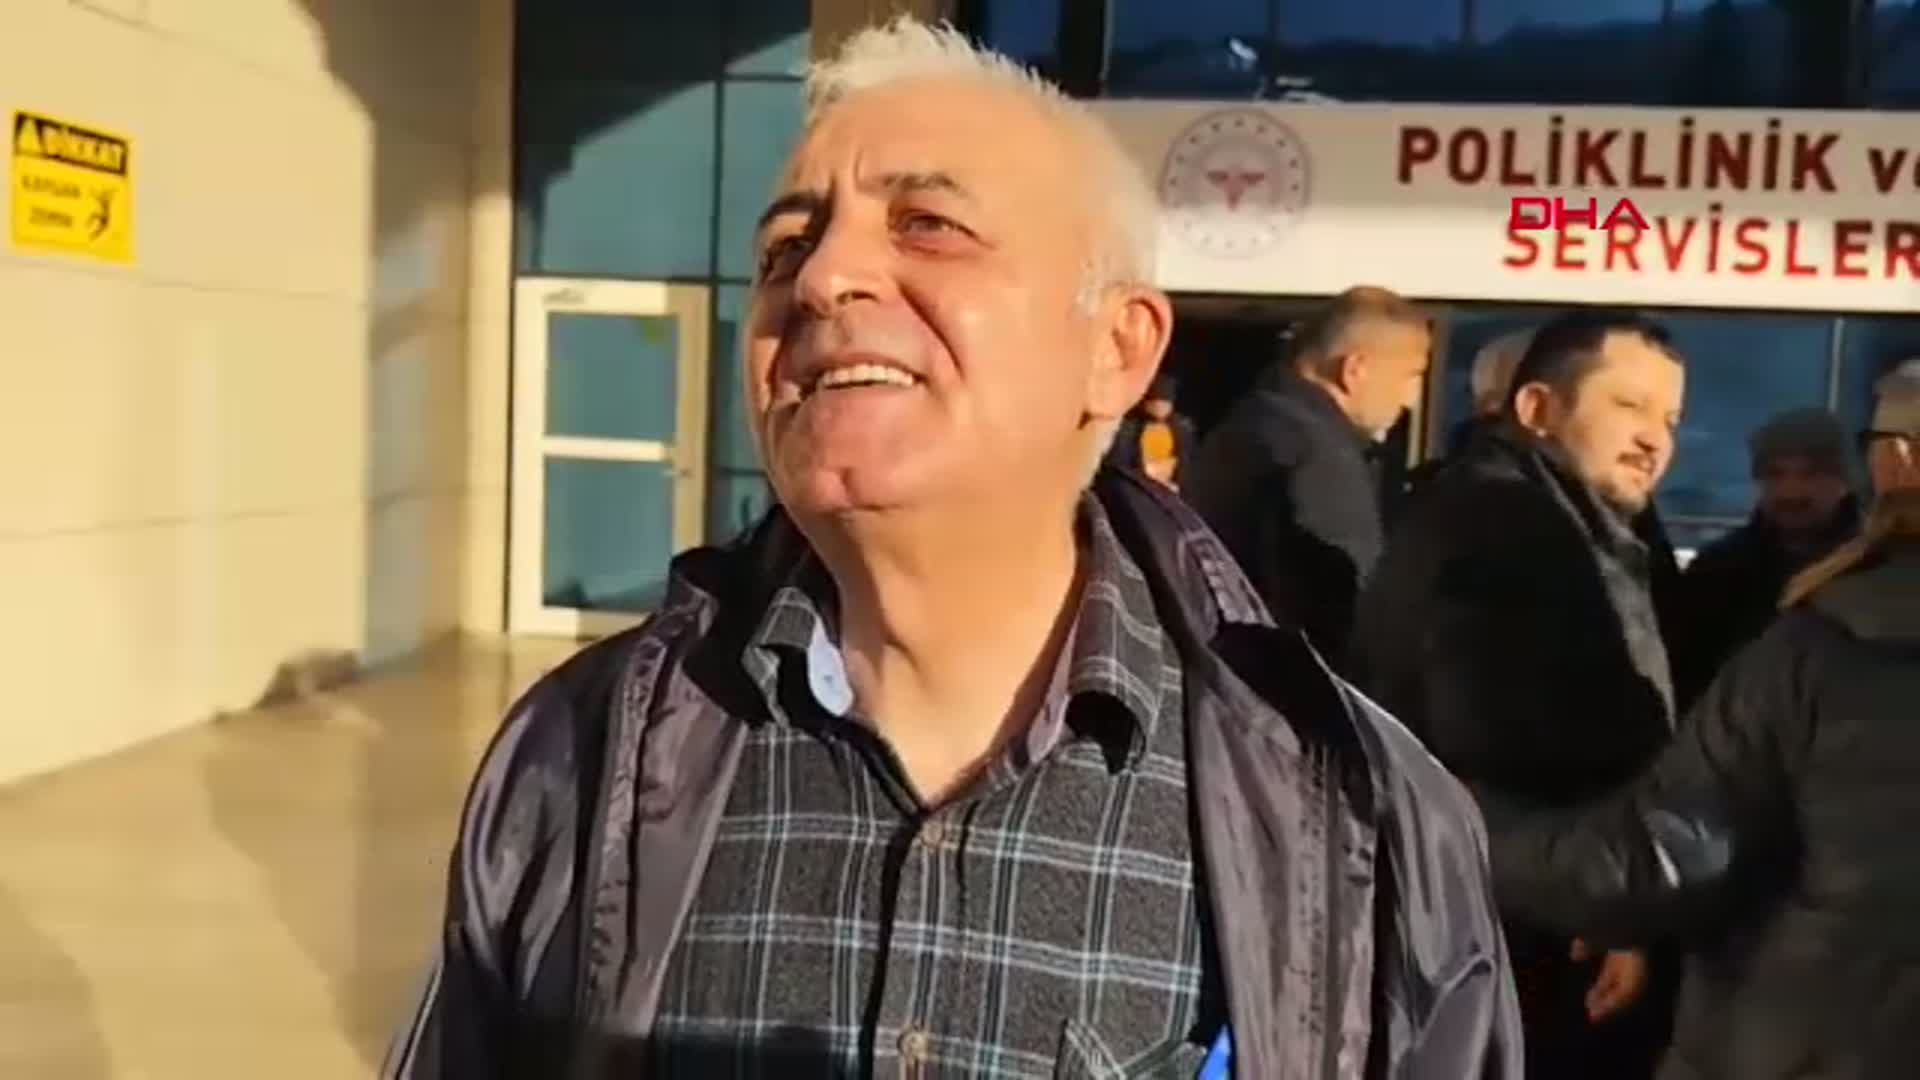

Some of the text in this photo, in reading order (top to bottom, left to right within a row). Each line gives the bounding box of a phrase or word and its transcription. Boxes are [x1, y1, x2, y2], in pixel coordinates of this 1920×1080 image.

[1397, 114, 1920, 193] POLİKLİNİK v
[1503, 203, 1920, 279] SERVİSLER
